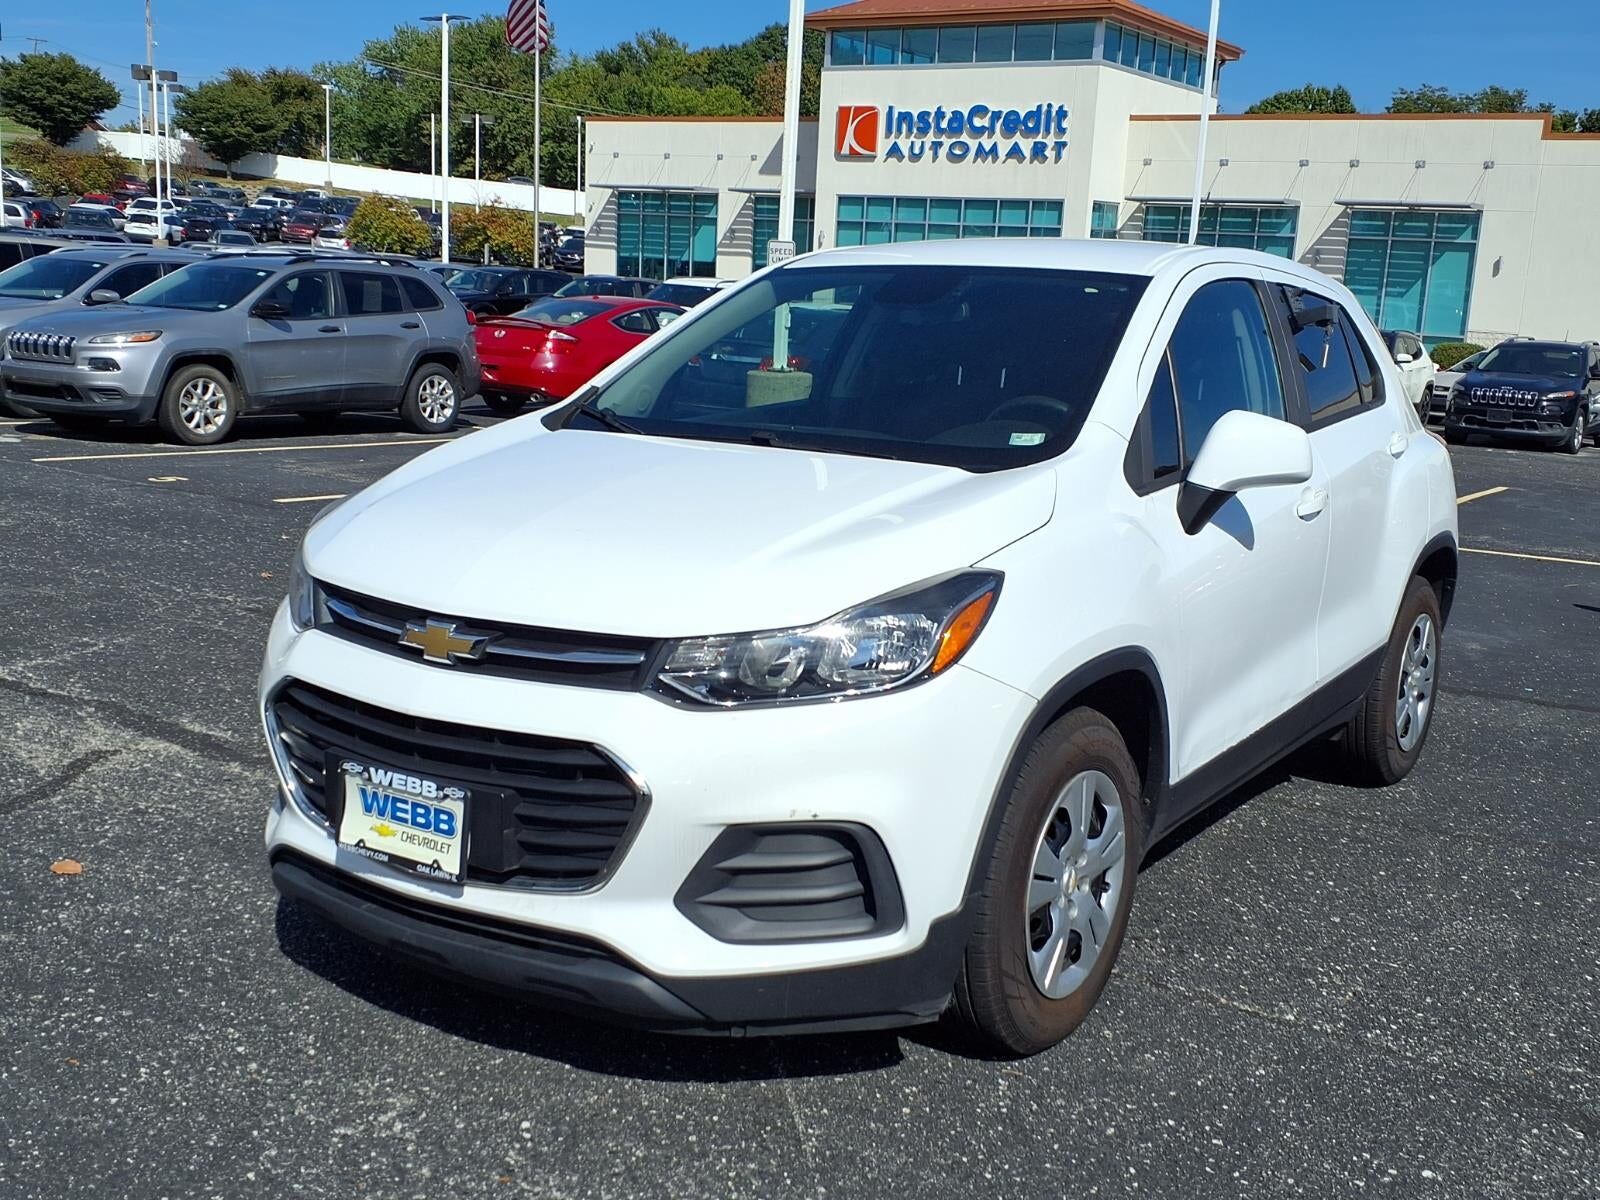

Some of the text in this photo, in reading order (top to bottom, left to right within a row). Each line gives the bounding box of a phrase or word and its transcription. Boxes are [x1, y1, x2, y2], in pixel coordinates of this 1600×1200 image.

[885, 103, 1069, 136] InstaCredit
[884, 140, 1069, 161] AUTOMART
[770, 247, 793, 256] SPEED
[368, 767, 438, 798] WEBB
[357, 785, 458, 839] WEBB
[400, 831, 452, 855] CHEVROLET
[416, 864, 431, 875] OAK
